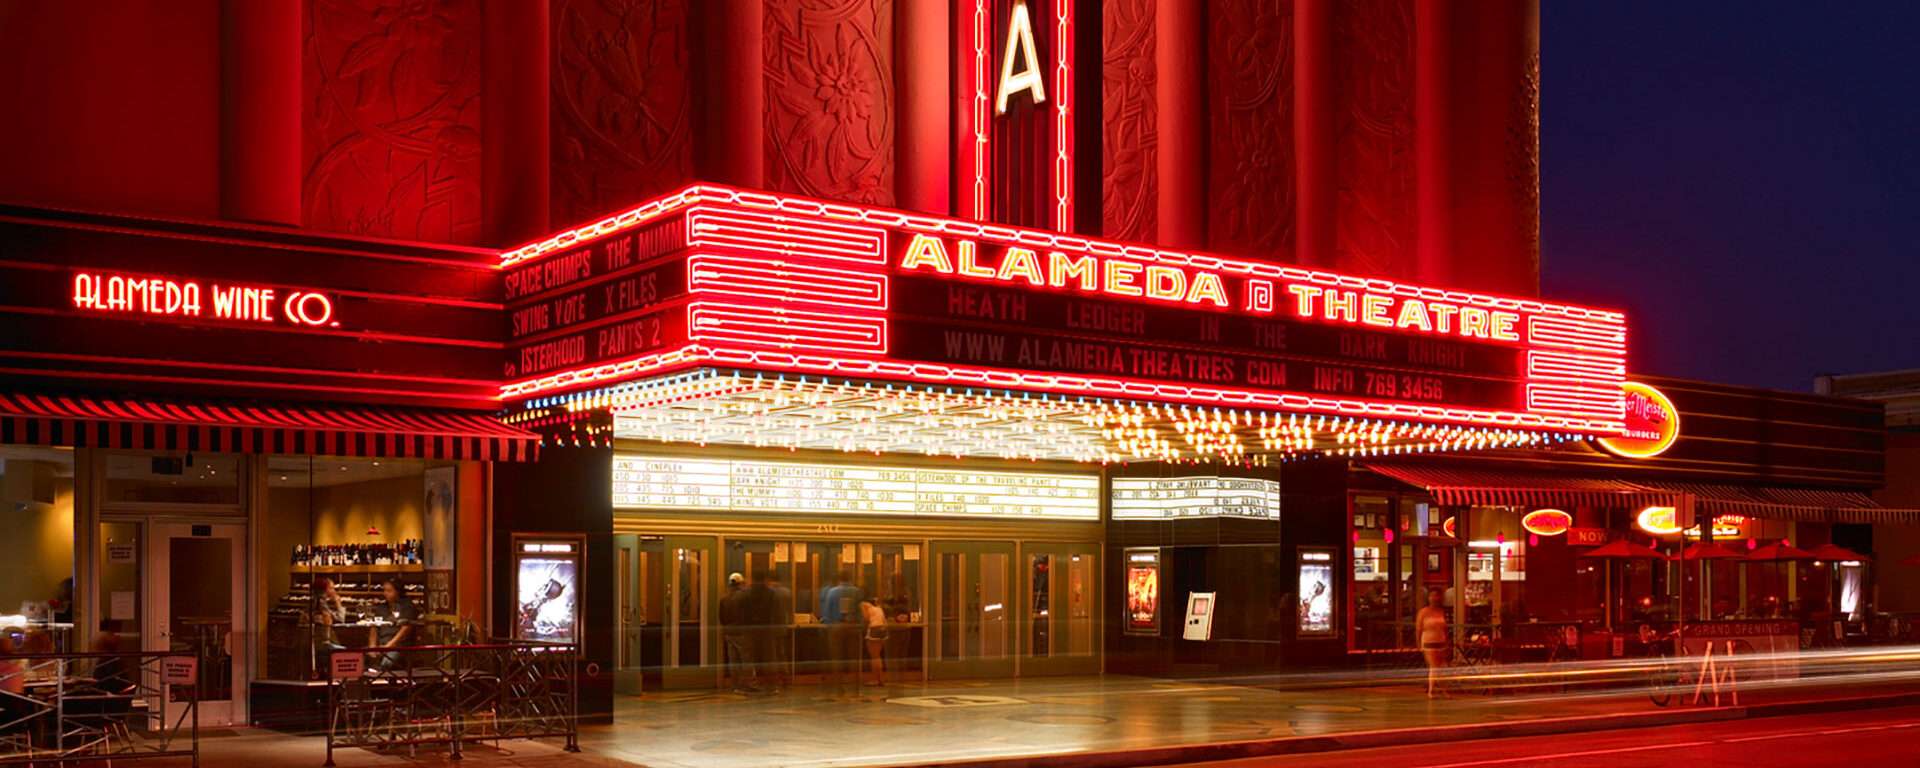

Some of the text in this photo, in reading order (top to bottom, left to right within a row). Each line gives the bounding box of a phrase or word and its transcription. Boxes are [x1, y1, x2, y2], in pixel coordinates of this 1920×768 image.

[995, 0, 1046, 116] A
[74, 273, 340, 326] ALAMEDA WINE CO.
[505, 265, 543, 299] SPACE
[544, 250, 591, 288] CHIMPS
[606, 236, 632, 270] THE
[900, 233, 1521, 341] ALAMEDA THEATRE
[513, 272, 657, 337] SWING VOTE X FILES
[949, 288, 1466, 368] HEATH LEDGER IN THE DARK KNIGHT
[598, 321, 643, 357] PANTS
[652, 318, 661, 346] 2
[944, 331, 1005, 362] WWW
[1247, 360, 1287, 386] COM
[1314, 366, 1354, 392] INFO
[1366, 371, 1397, 397] 769
[1402, 376, 1443, 400] 3456
[1696, 624, 1781, 635] GRAND OPENING
